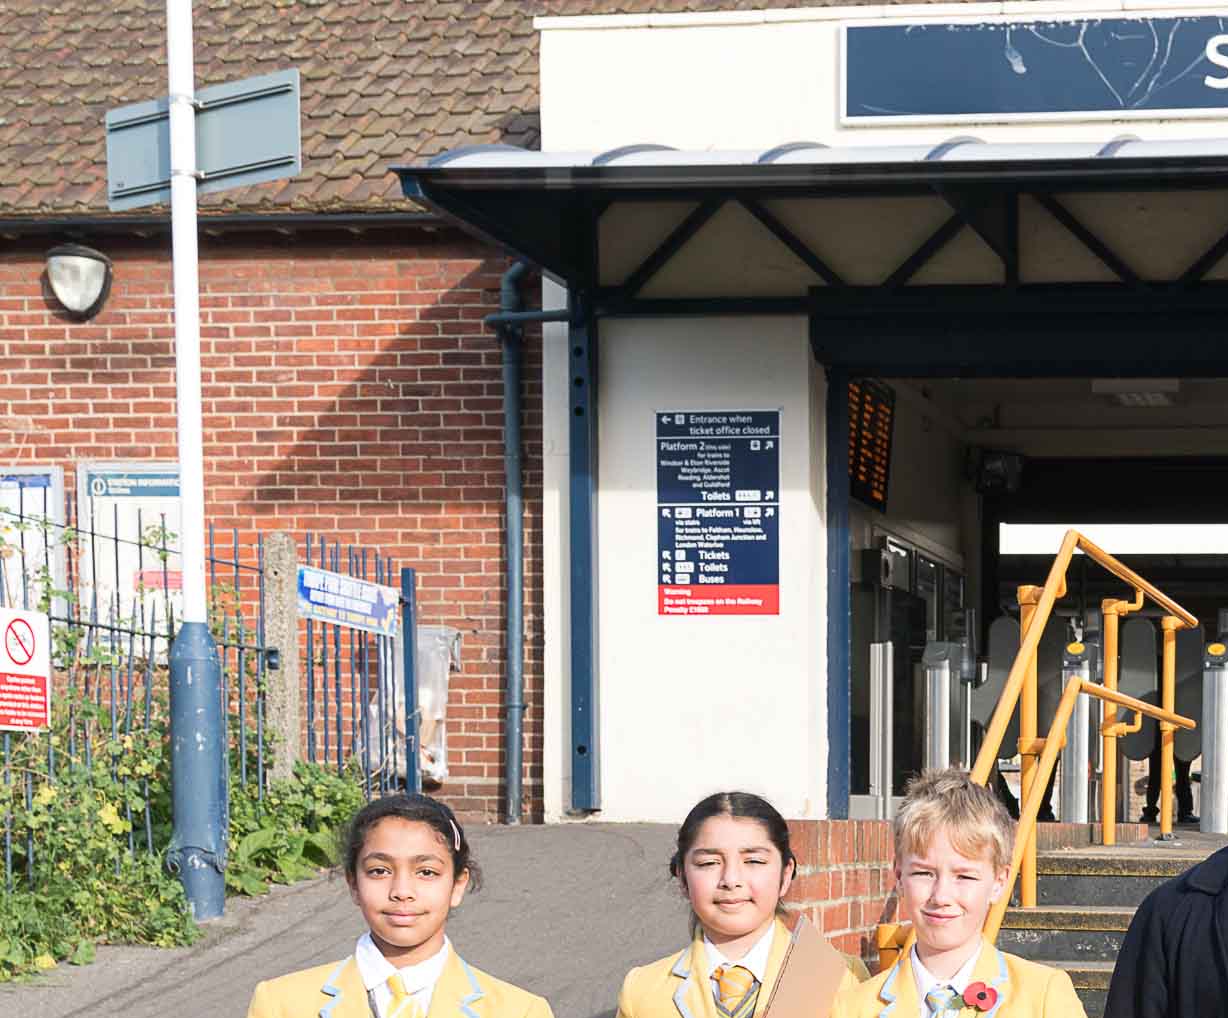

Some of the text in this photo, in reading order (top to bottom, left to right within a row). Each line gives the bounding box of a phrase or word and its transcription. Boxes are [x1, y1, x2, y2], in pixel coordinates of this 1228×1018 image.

[690, 415, 752, 424] Entrance when
[690, 426, 770, 435] ticket office closed
[661, 442, 697, 451] Platform
[699, 442, 705, 450] 2
[701, 491, 731, 500] Toilets
[696, 508, 739, 517] Platform 1
[699, 551, 730, 560] Tickets
[699, 563, 728, 571] Toilets
[699, 575, 725, 583] Buses
